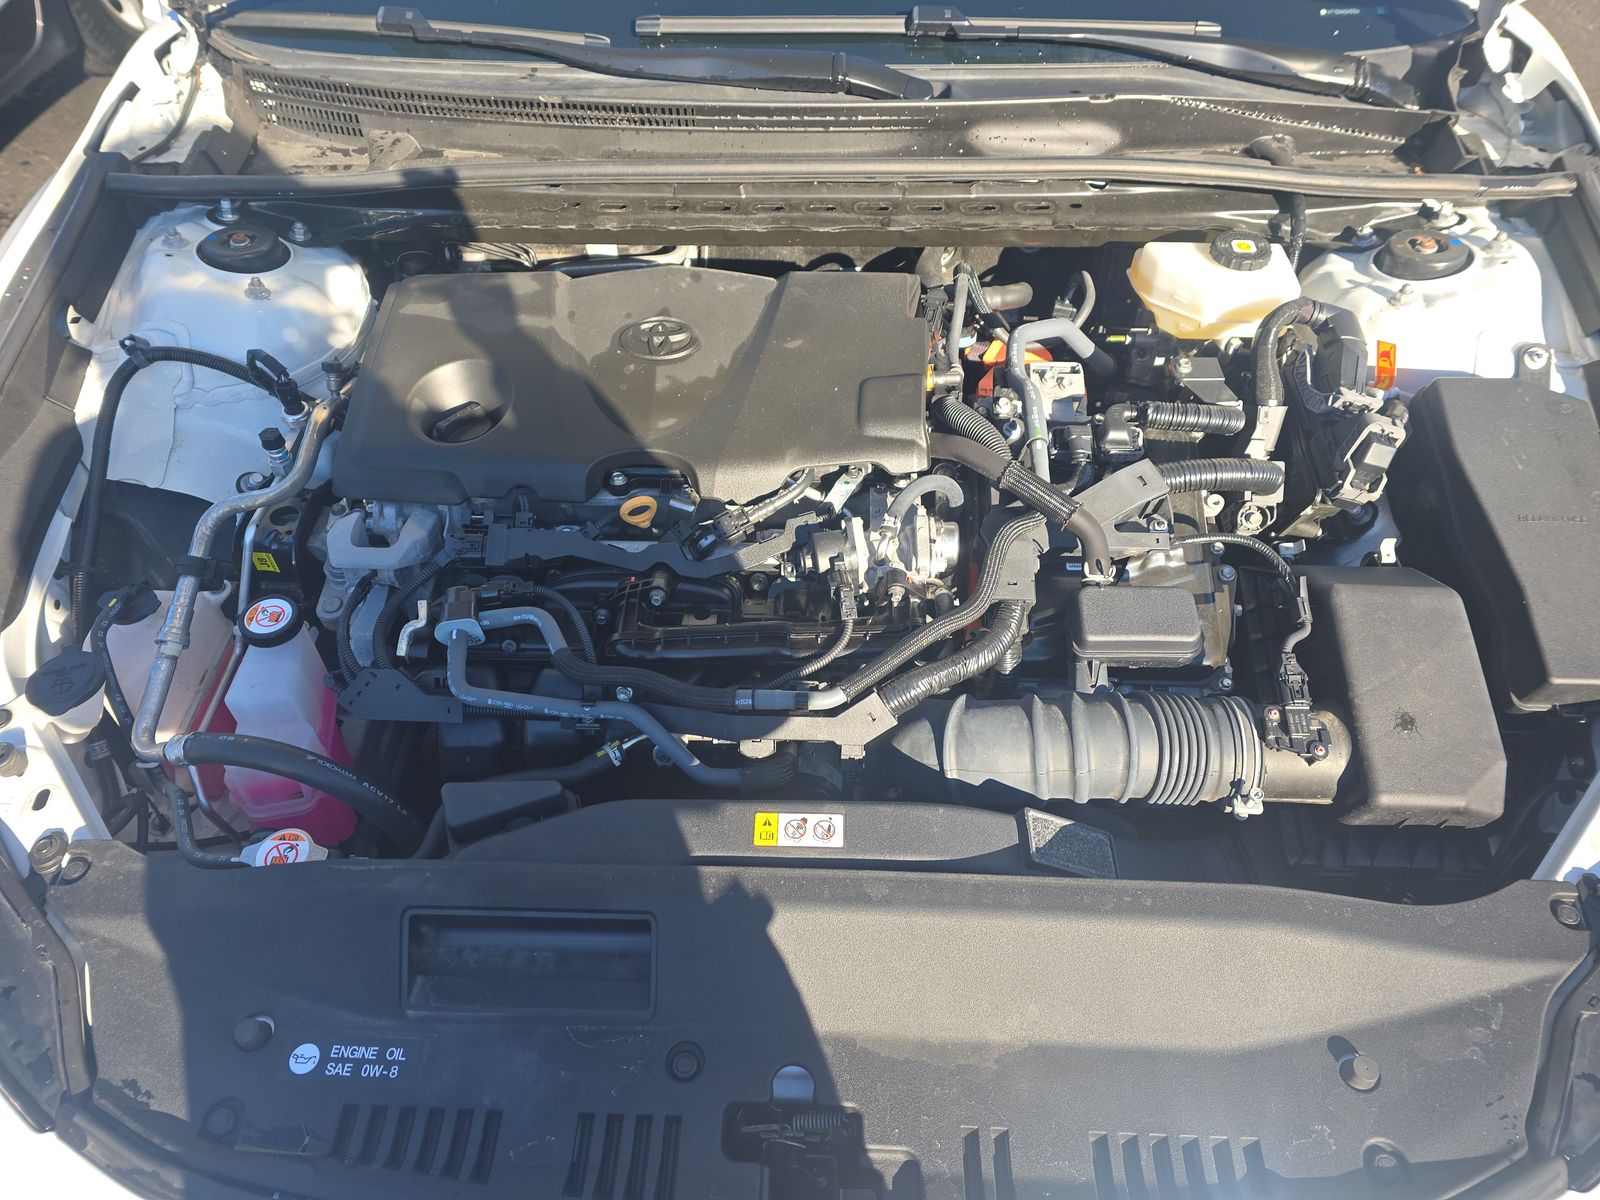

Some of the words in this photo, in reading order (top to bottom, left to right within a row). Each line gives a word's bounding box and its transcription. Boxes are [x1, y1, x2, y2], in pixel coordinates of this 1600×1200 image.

[316, 758, 357, 781] YOKOHAMA
[362, 782, 395, 804] ACV17
[330, 1045, 379, 1060] ENGINE
[386, 1047, 406, 1061] OIL
[325, 1062, 353, 1076] SAE
[361, 1064, 399, 1079] 0W-8
